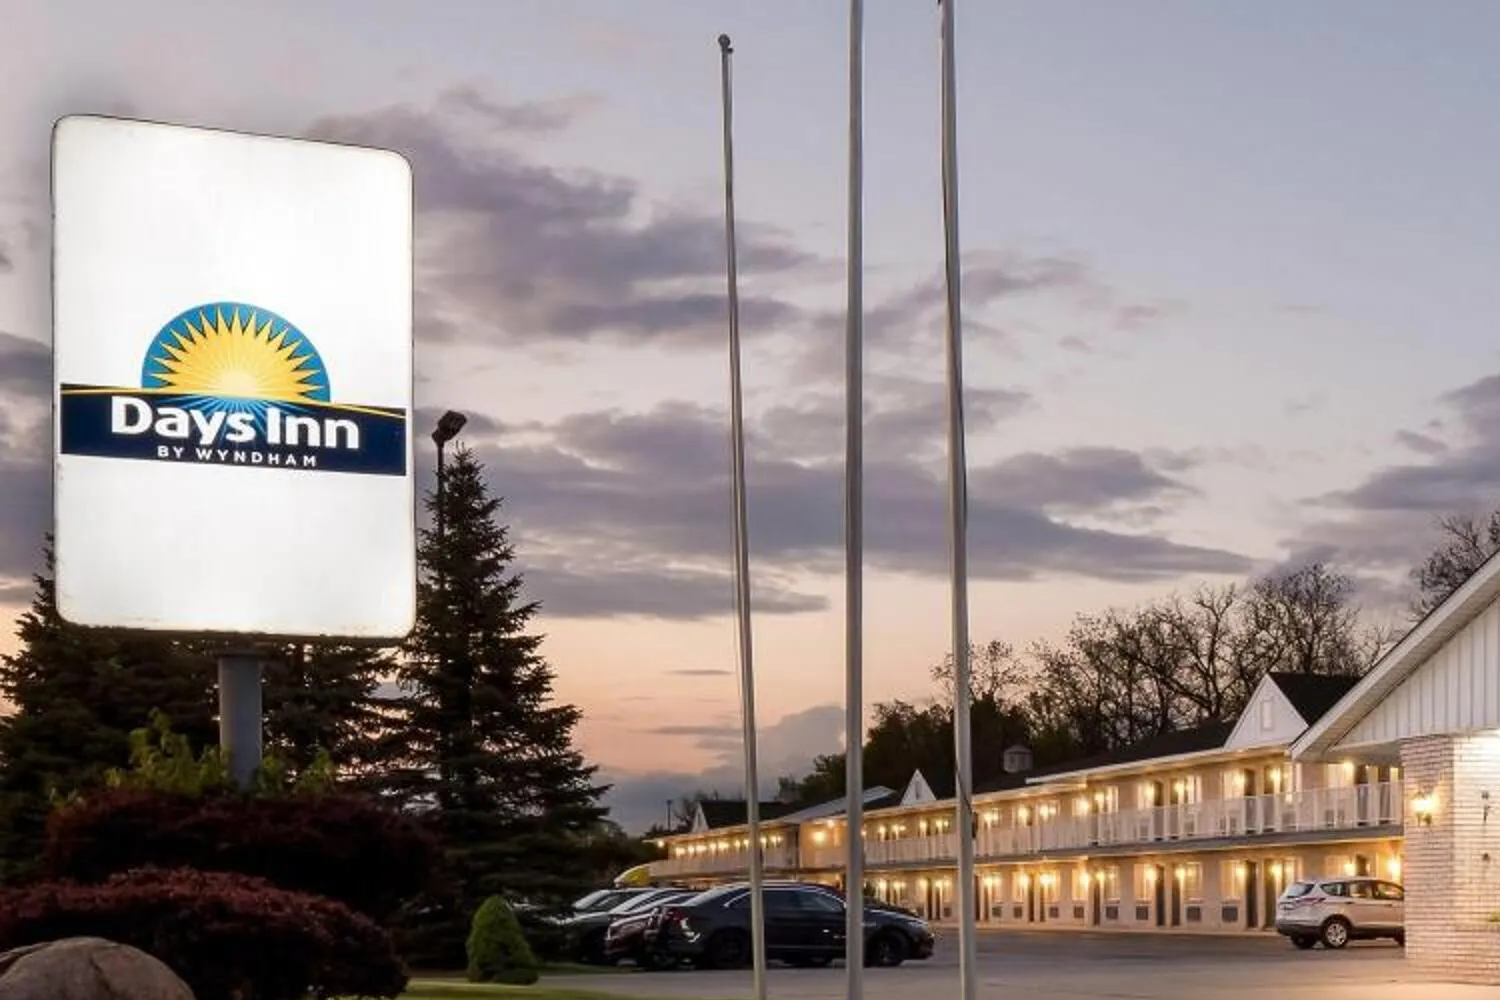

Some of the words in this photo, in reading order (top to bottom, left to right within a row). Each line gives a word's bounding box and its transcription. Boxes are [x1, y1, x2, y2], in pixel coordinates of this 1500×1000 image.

[111, 395, 256, 445] Days
[266, 407, 359, 449] Inn
[157, 445, 184, 459] BY
[195, 447, 317, 467] WYNDHAM
